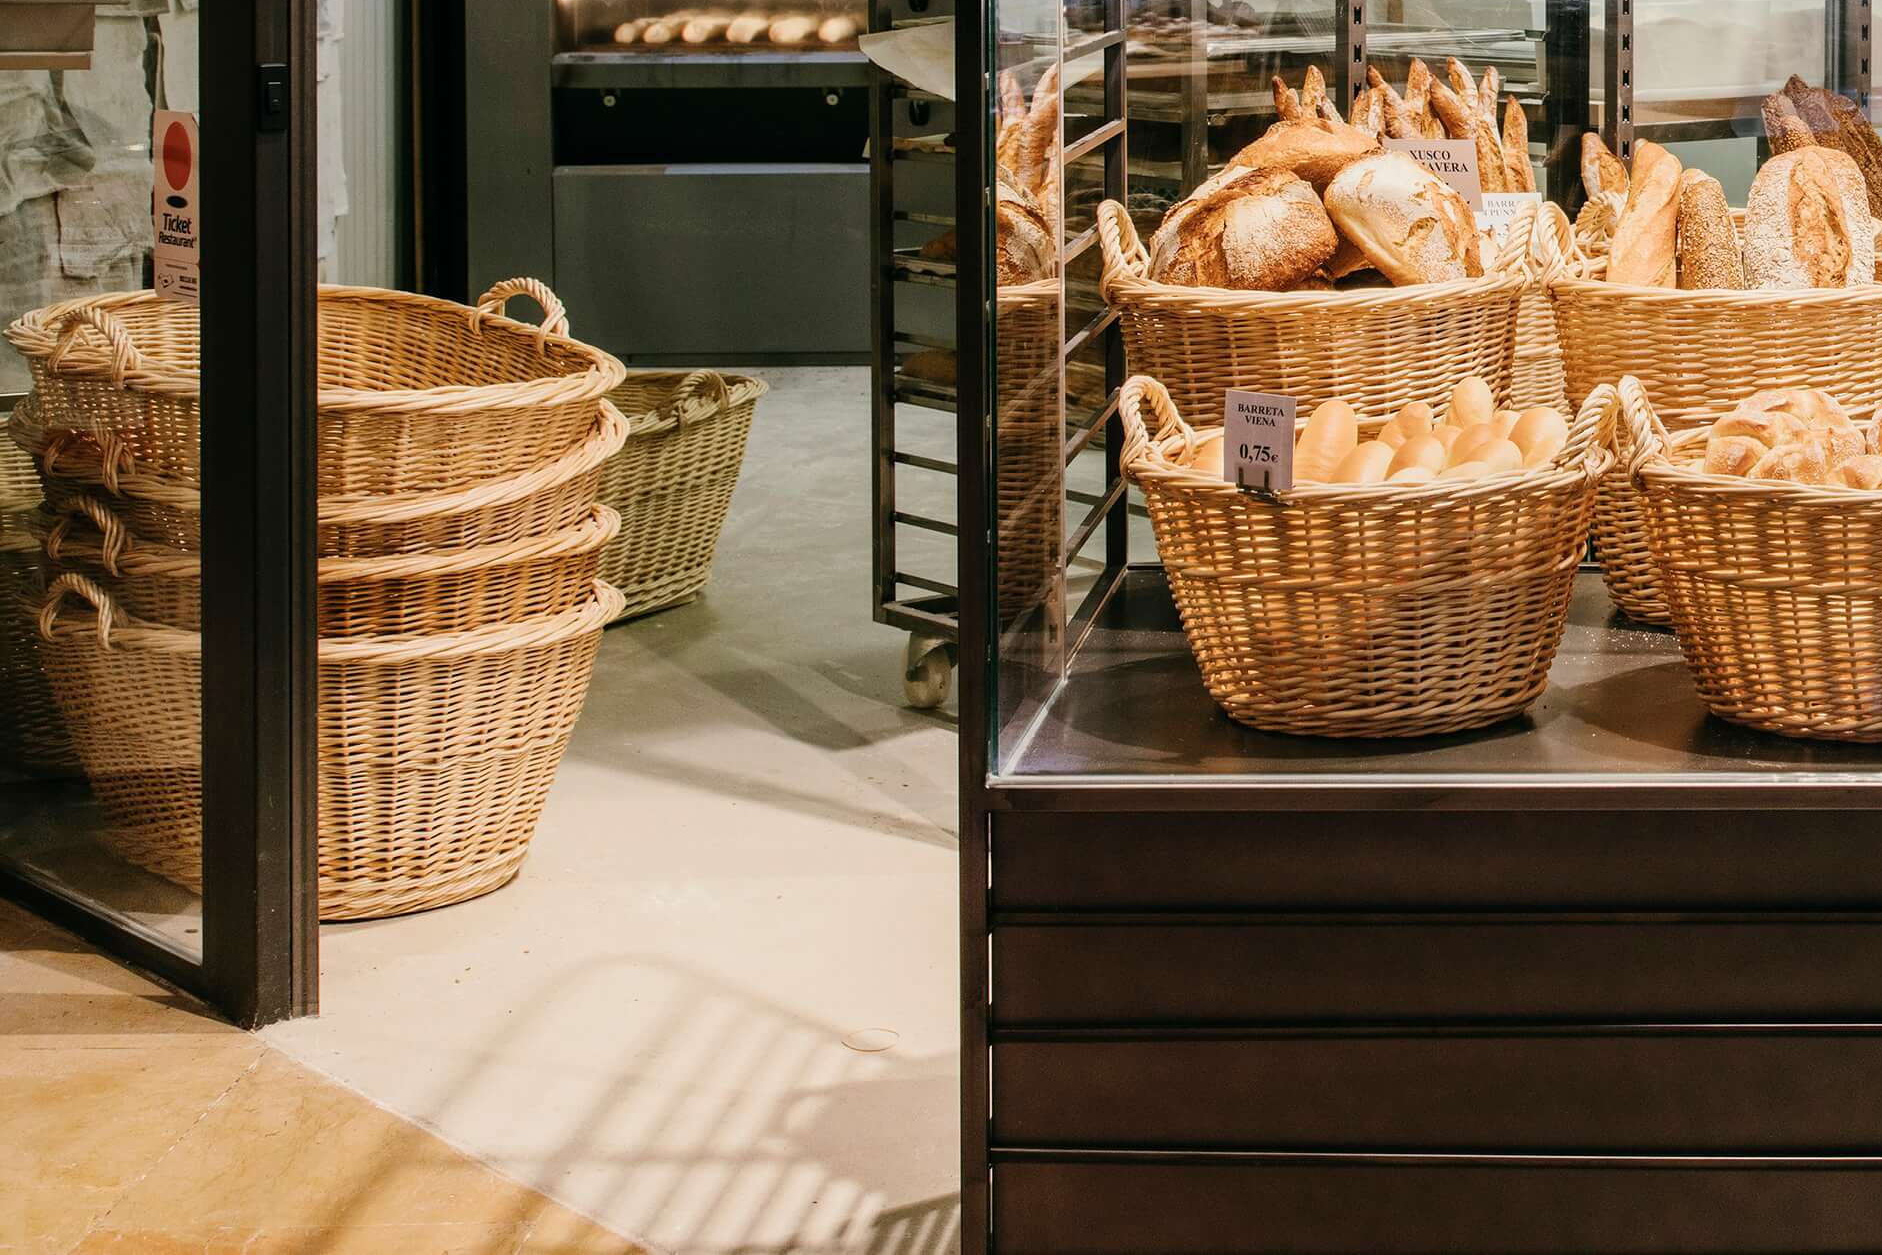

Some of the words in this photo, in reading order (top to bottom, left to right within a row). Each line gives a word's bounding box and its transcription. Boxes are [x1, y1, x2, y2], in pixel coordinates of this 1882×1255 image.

[1410, 149, 1451, 161] XUSCO
[1421, 162, 1469, 173] AVERA
[162, 212, 193, 235] Ticket
[158, 231, 195, 249] Restaurant
[1237, 403, 1285, 418] BARRETA
[1244, 415, 1276, 427] VIENA
[1239, 443, 1280, 464] 0,75€
